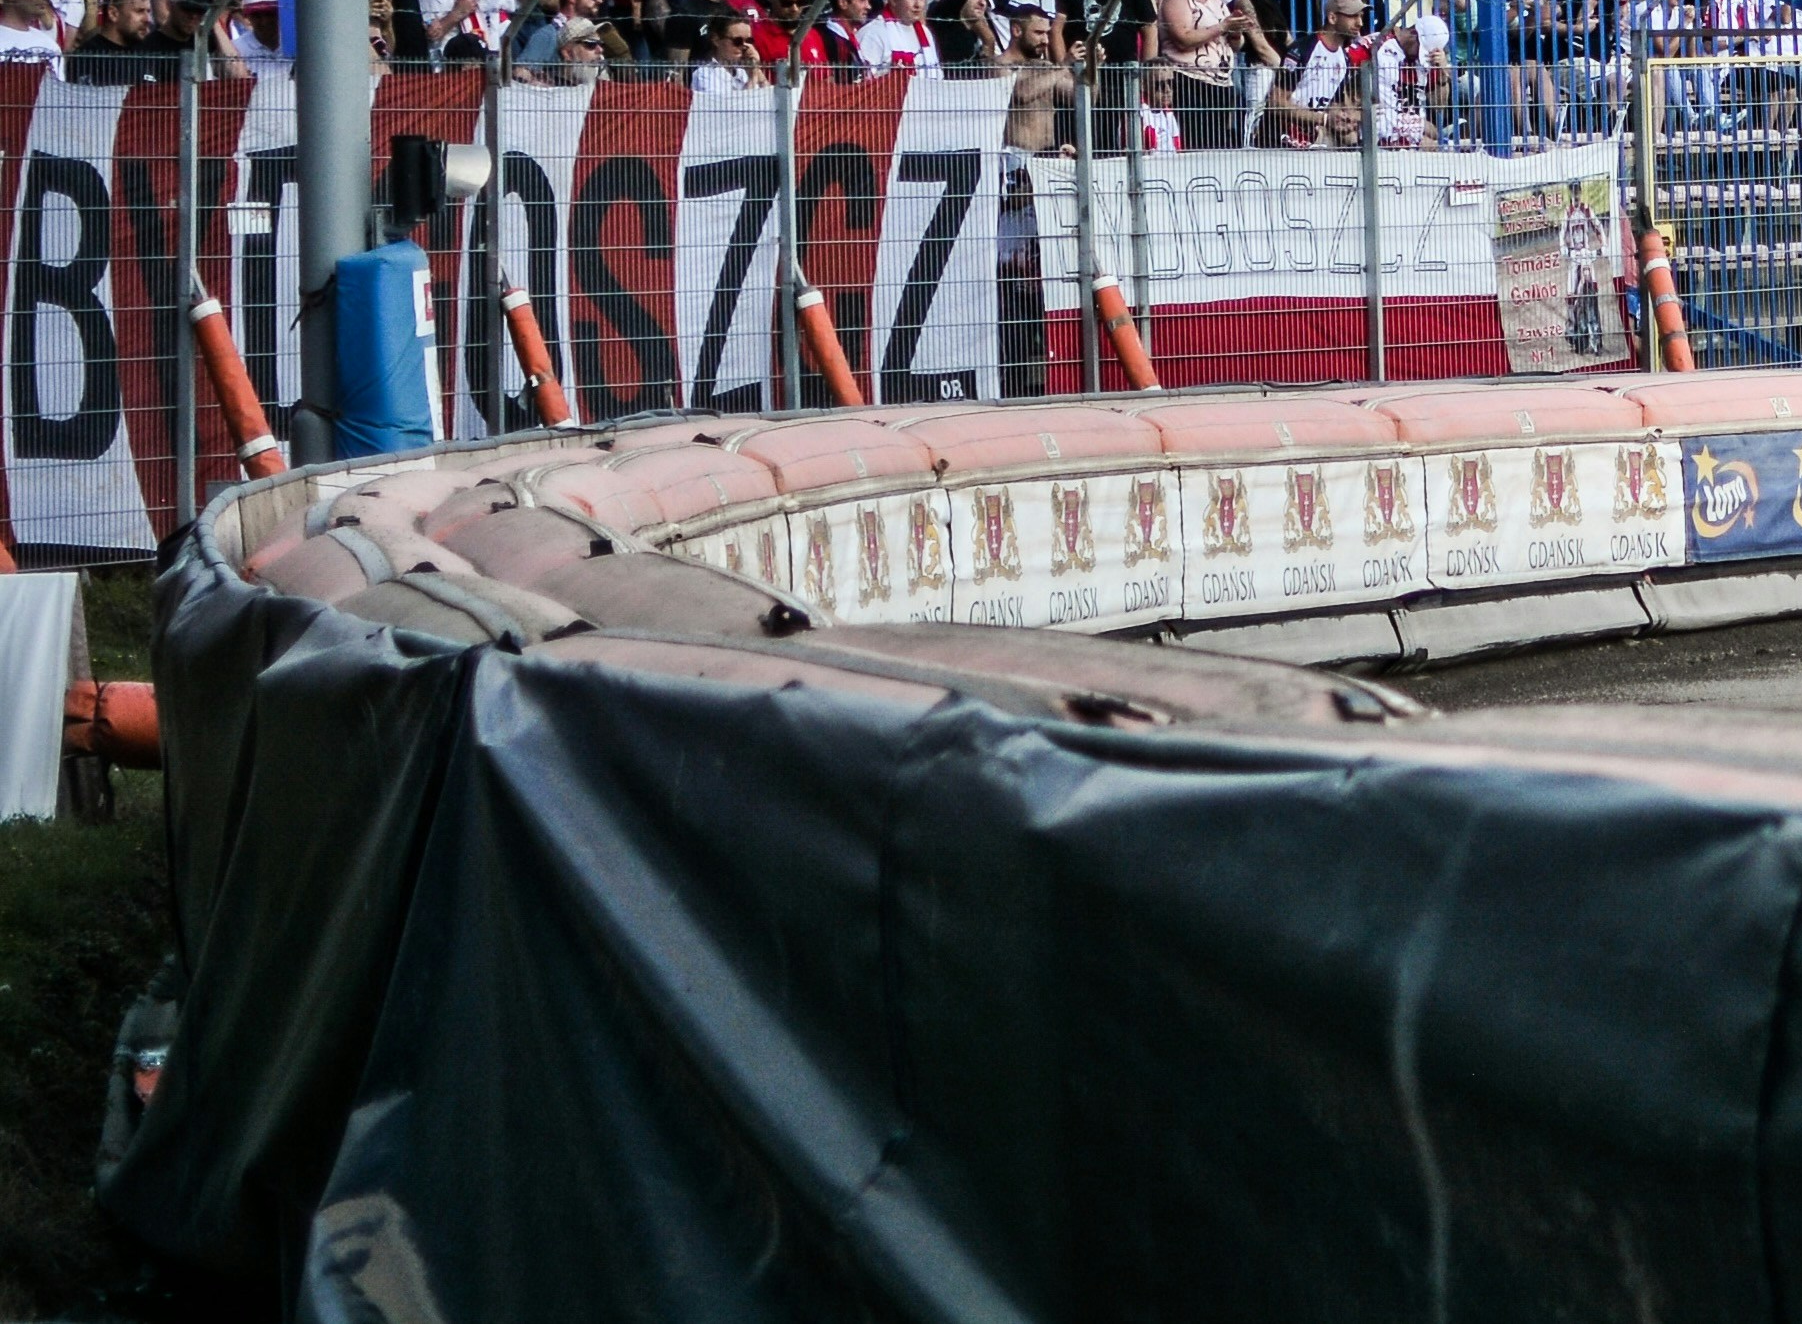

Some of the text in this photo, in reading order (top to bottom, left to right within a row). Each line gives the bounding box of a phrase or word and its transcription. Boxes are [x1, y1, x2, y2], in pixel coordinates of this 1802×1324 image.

[1048, 171, 1451, 283] BYDGOSZCZ
[1503, 251, 1560, 275] Tomasz
[9, 143, 981, 460] BYOSZCZ
[1511, 282, 1558, 307] Gollob
[1517, 324, 1564, 343] Zawsze
[1703, 477, 1748, 522] LOTTO
